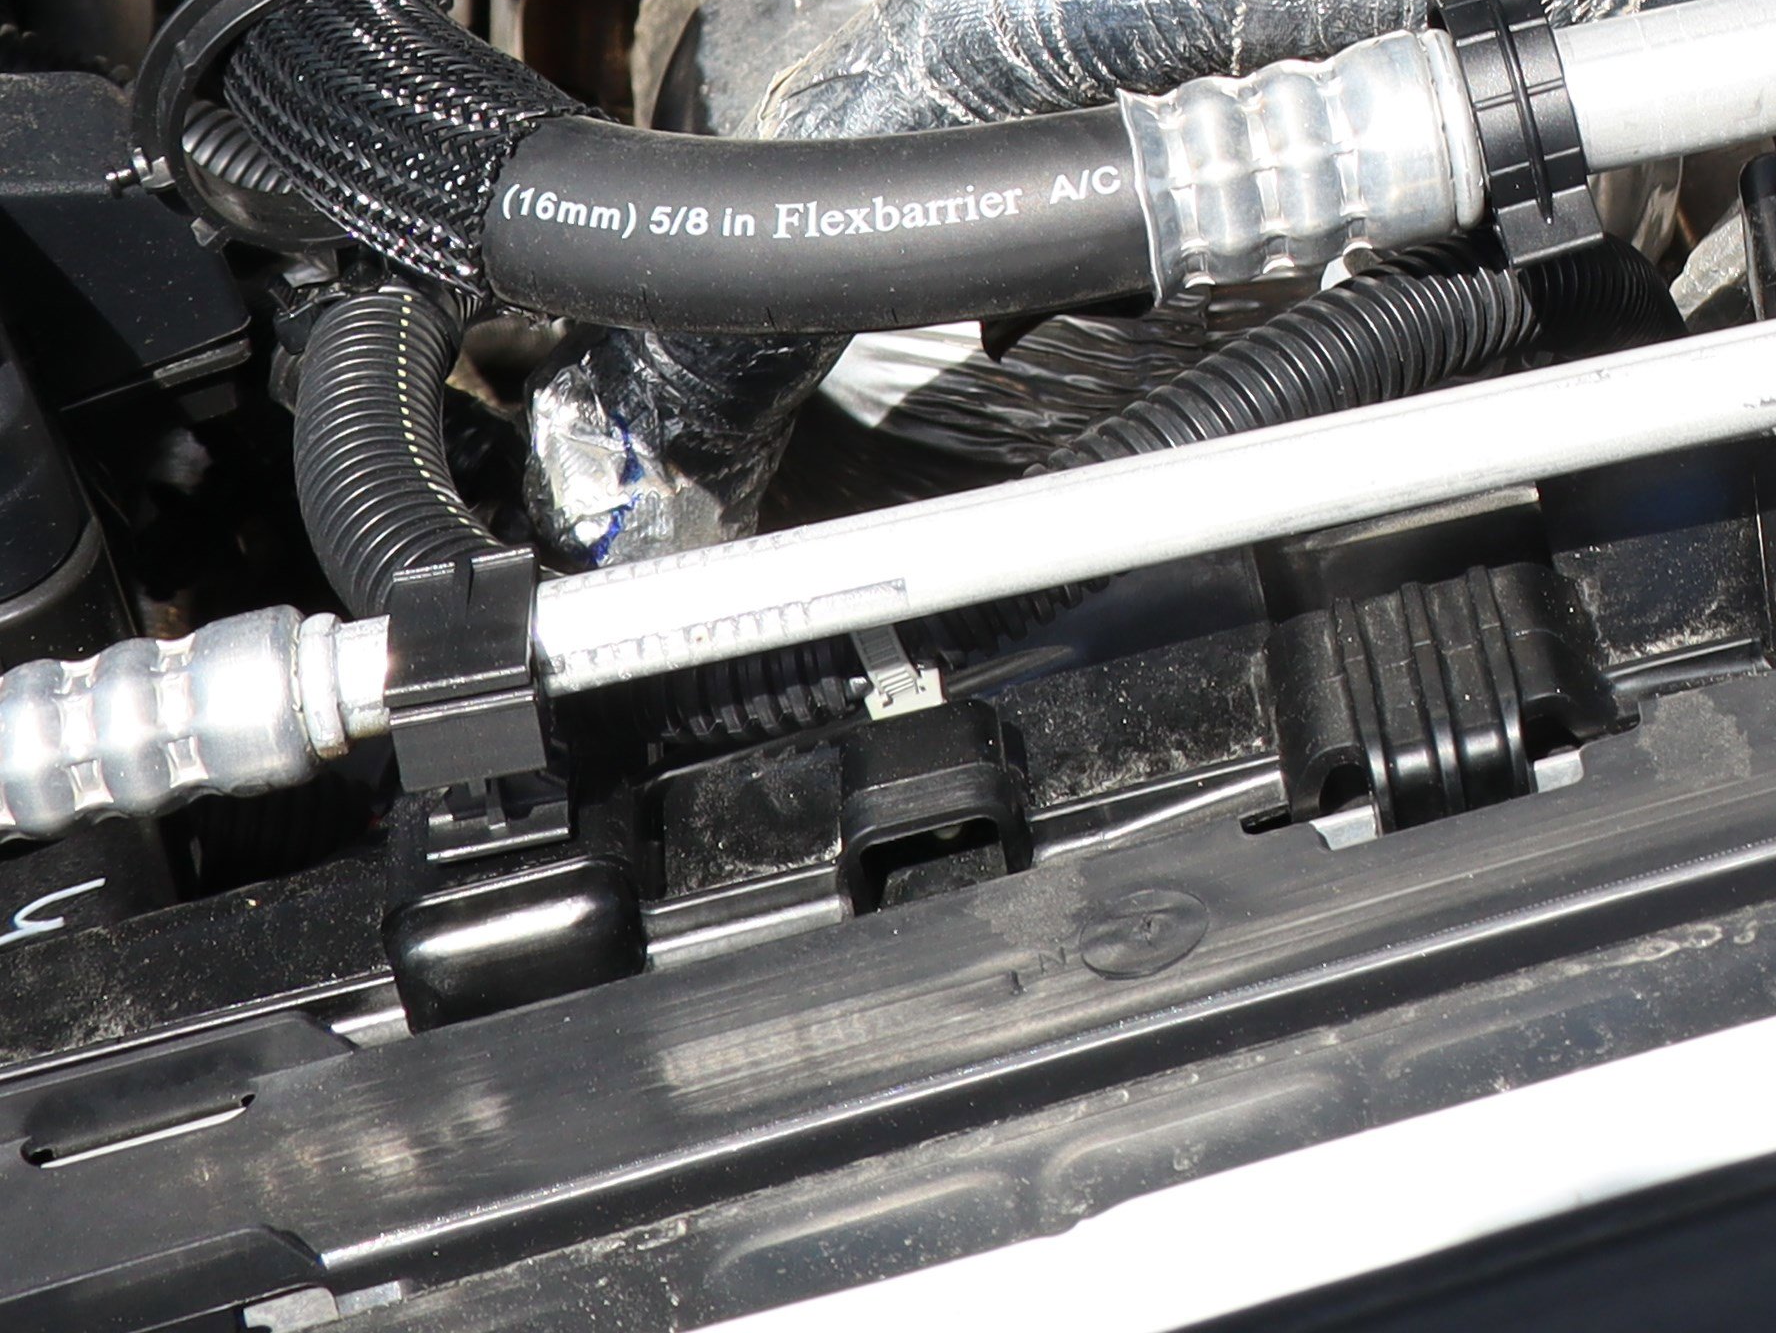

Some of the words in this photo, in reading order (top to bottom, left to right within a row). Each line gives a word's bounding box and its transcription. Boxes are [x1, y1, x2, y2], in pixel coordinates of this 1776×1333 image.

[502, 184, 637, 239] (16mm)
[649, 205, 710, 236] 5/8
[721, 207, 756, 237] in
[772, 185, 1023, 240] Flexbarrier
[1049, 165, 1122, 205] A/C
